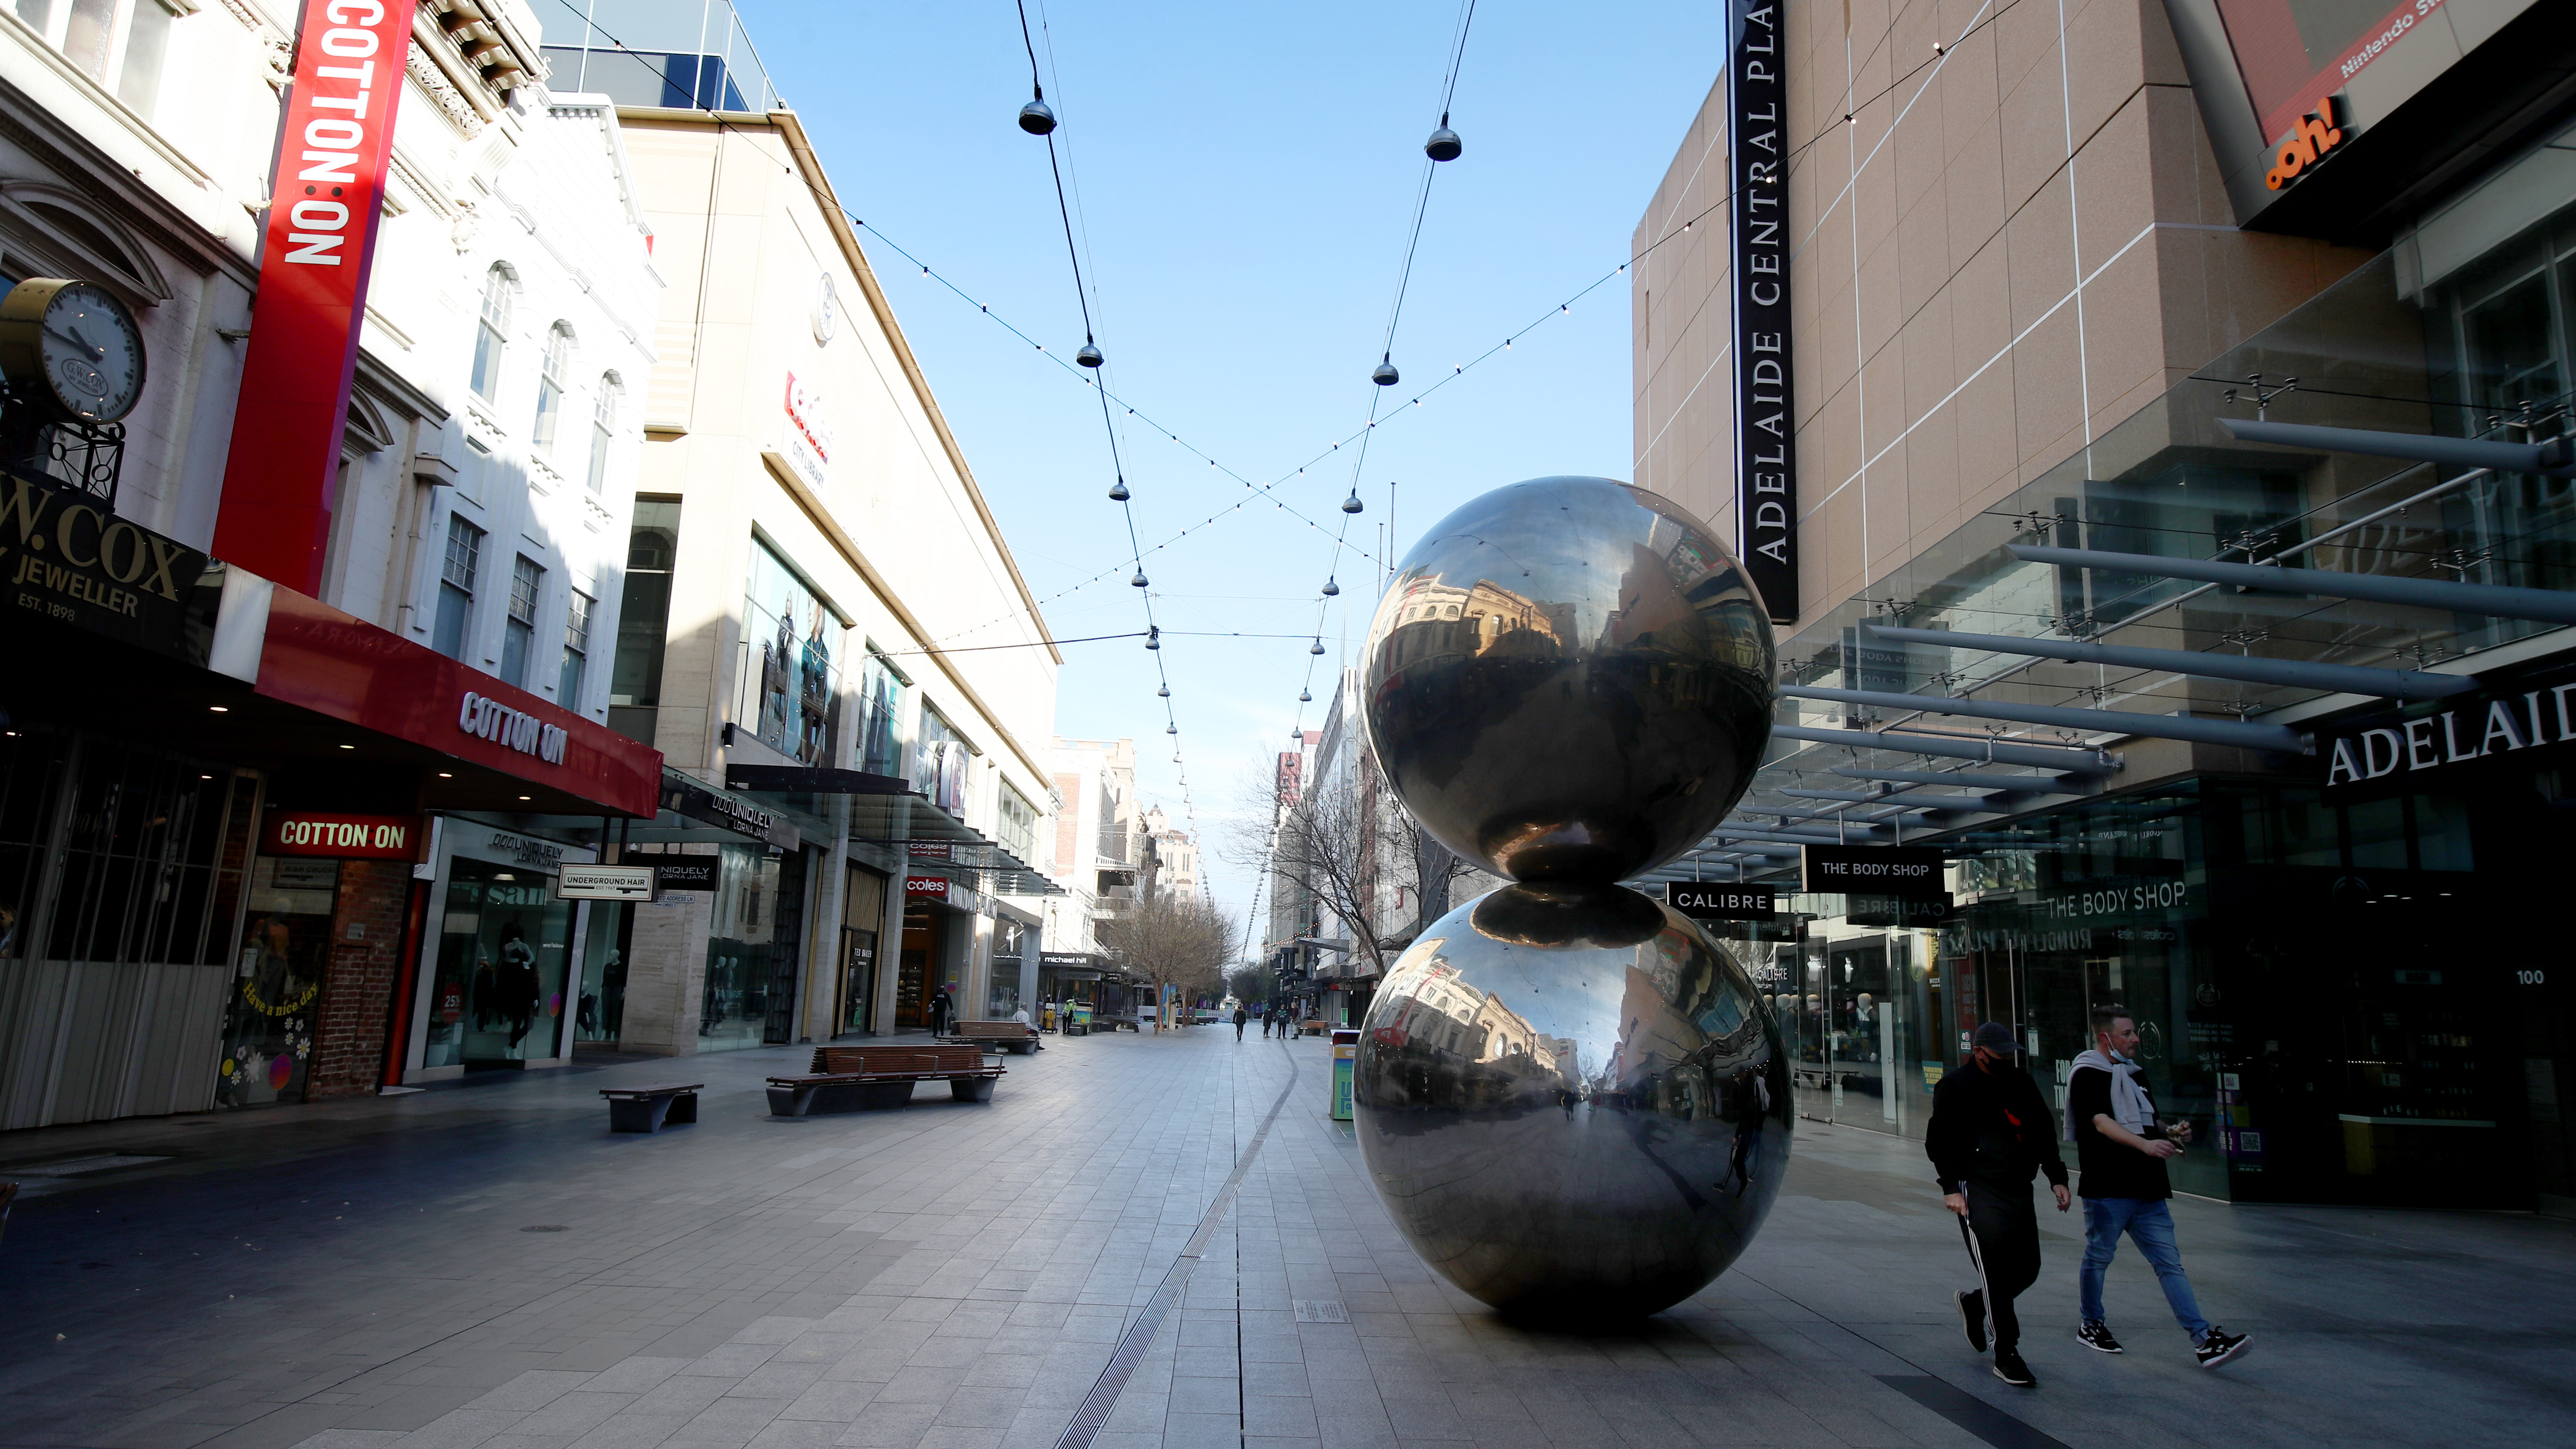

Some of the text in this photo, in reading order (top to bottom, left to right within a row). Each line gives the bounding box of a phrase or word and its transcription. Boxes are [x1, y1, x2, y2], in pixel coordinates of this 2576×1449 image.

[2340, 14, 2414, 79] Nintendo
[1745, 5, 1787, 565] ADELAIDE CENTRAL PLA
[793, 440, 825, 490] CITY LIBRARY
[11, 555, 138, 618] JEWELLER
[17, 592, 75, 622] EST. 1898
[733, 820, 769, 840] LORNA JANE
[567, 877, 625, 885] UNDERGROUND
[1821, 862, 1929, 876] THE BODY SHOP
[907, 878, 945, 891] coles
[1678, 893, 1767, 909] CALIBRE
[2046, 895, 2077, 918] THE
[2083, 888, 2128, 915] BODY
[2516, 970, 2544, 984] 100
[242, 981, 318, 1017] Have a nice day
